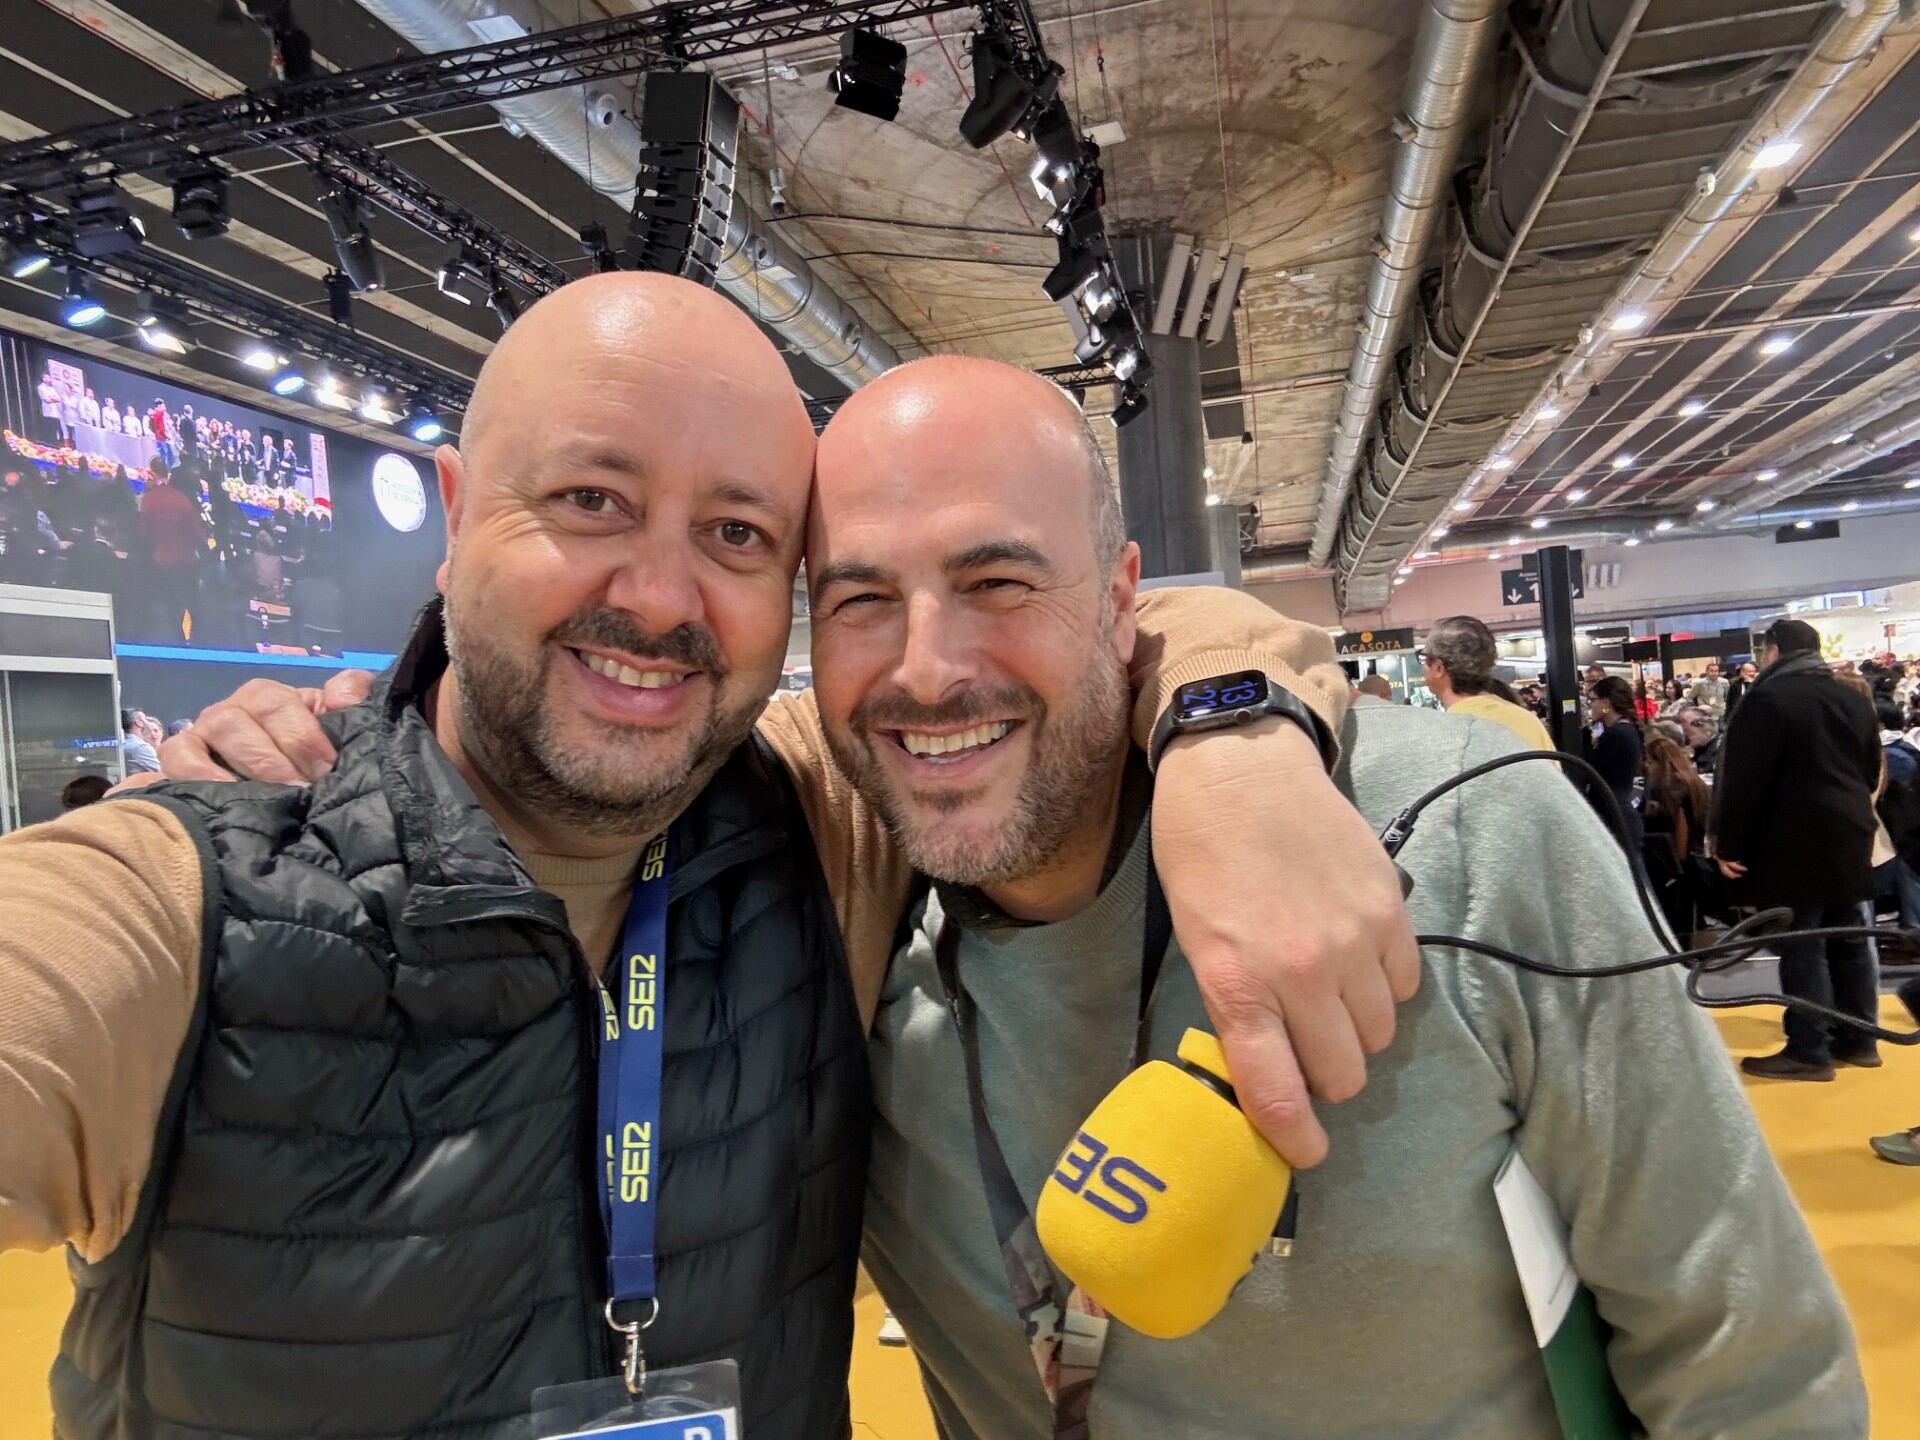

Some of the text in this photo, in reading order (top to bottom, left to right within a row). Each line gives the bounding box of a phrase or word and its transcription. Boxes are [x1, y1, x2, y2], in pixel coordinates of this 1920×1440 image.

[1220, 680, 1257, 704] 13
[641, 835, 668, 881] SE
[628, 954, 656, 1031] SER
[620, 1121, 651, 1203] SER
